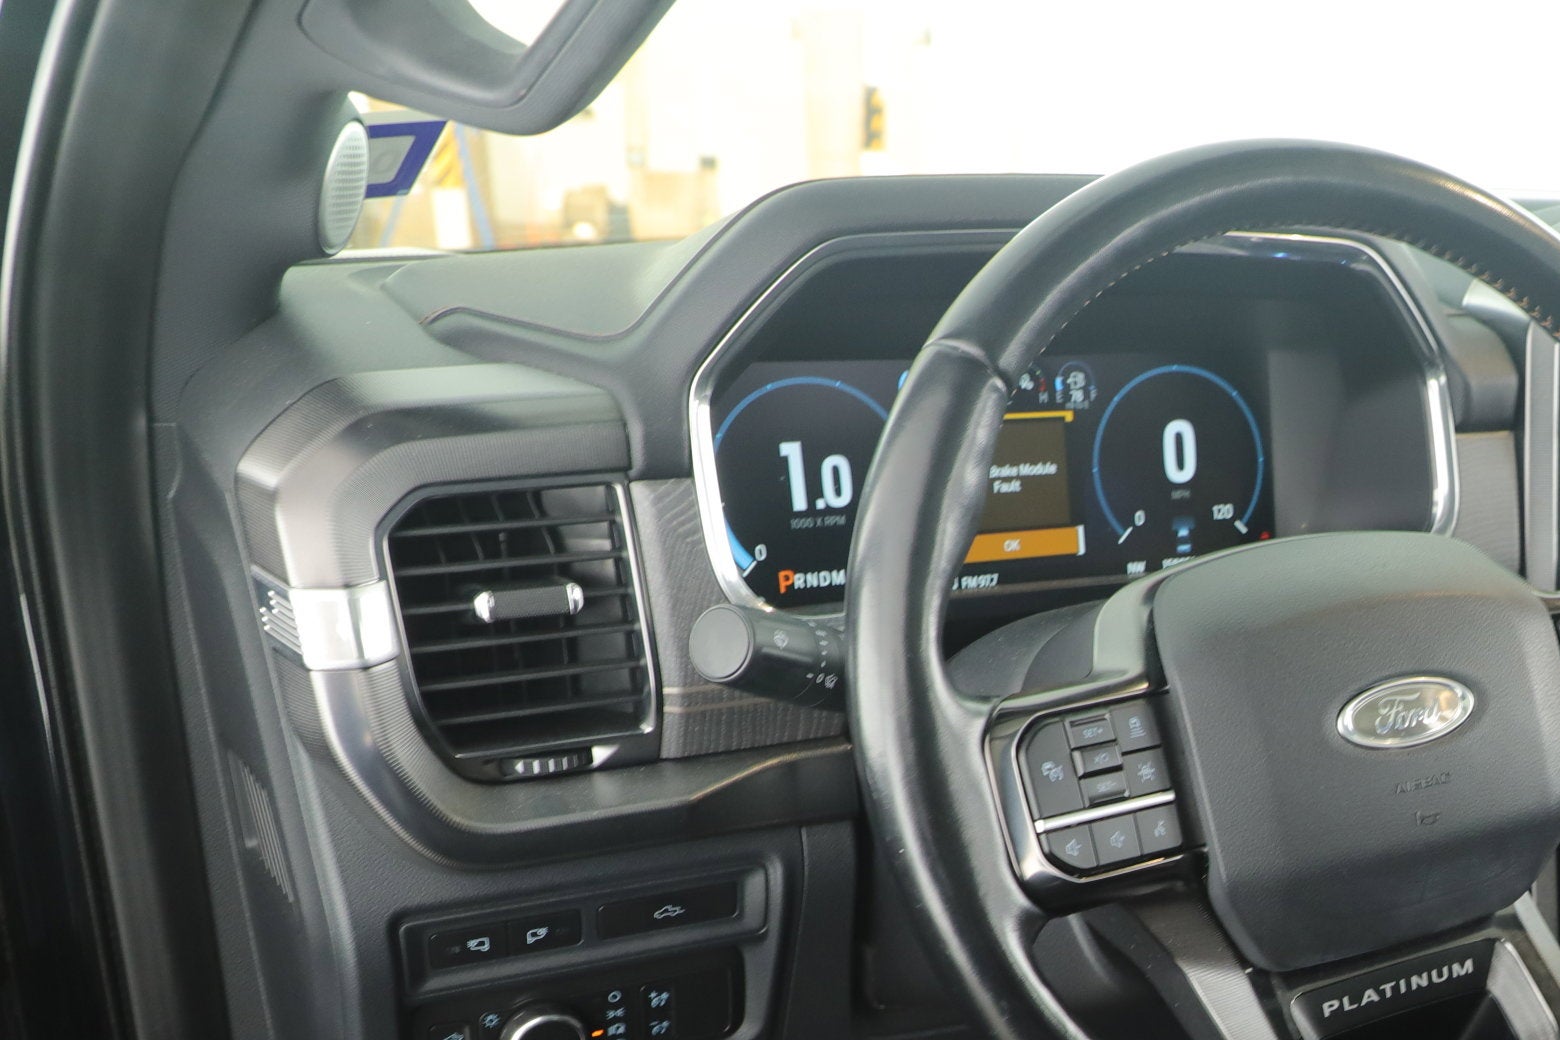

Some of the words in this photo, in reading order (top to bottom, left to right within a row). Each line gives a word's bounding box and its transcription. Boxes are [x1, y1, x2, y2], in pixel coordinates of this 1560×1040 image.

[1162, 418, 1197, 484] 0
[779, 441, 853, 512] 1.0
[989, 464, 1018, 478] Brake
[1019, 461, 1058, 476] Module
[993, 479, 1022, 493] Fault
[1133, 509, 1146, 527] 0
[1212, 503, 1234, 520] 120
[824, 515, 847, 527] RPM
[754, 543, 768, 561] 0
[1003, 539, 1021, 552] OK
[1374, 692, 1441, 735] Ford
[1321, 958, 1475, 1019] PLATINUM
